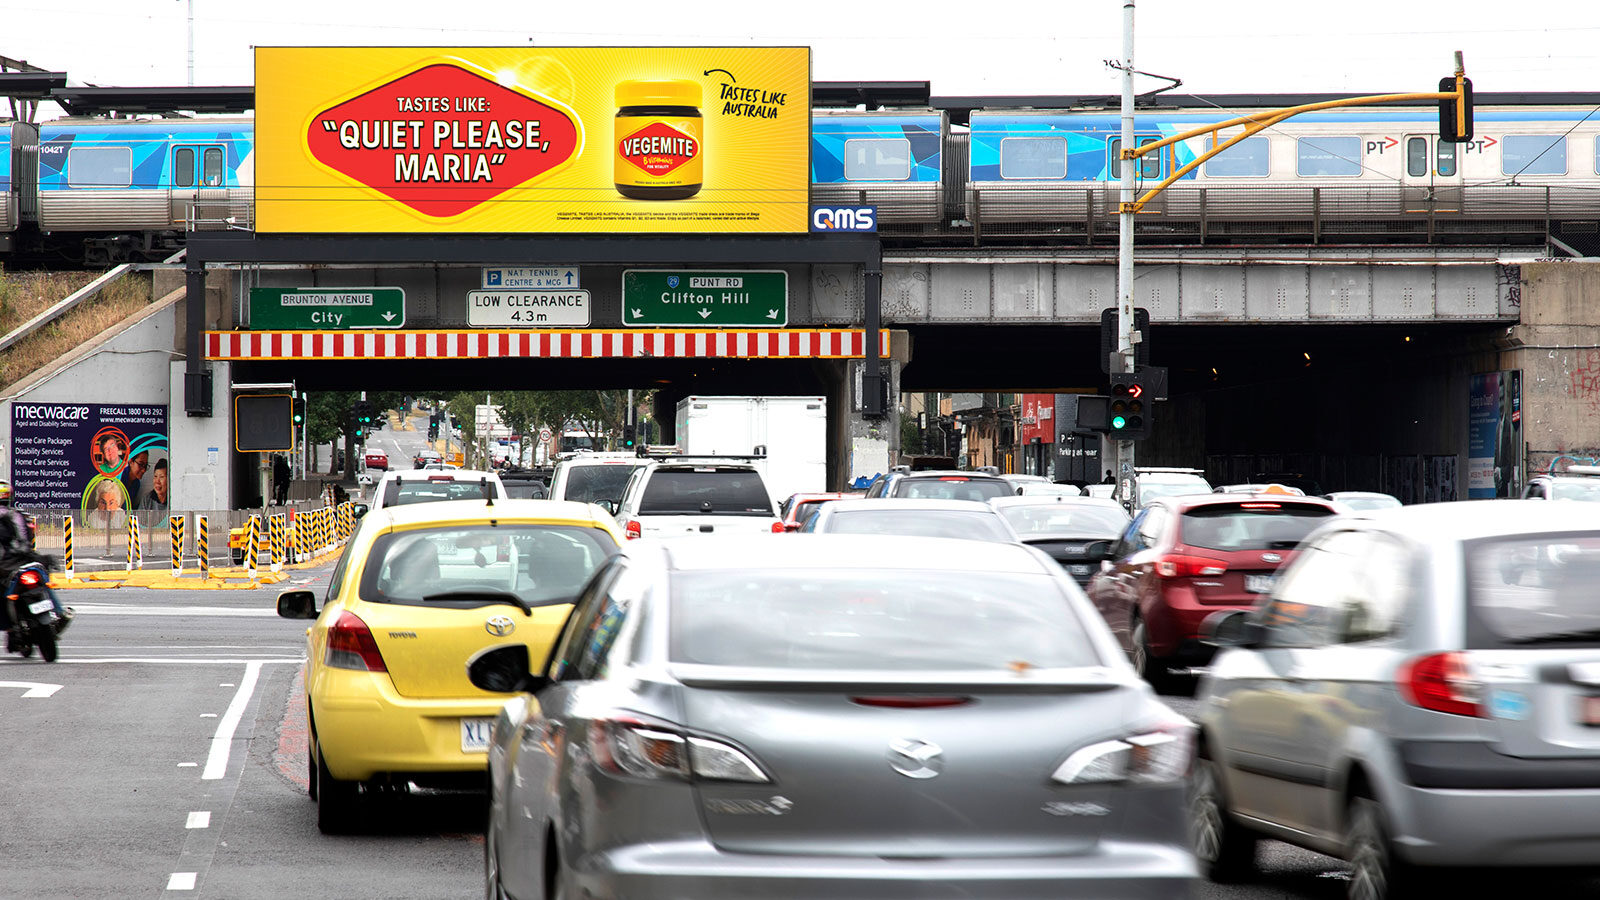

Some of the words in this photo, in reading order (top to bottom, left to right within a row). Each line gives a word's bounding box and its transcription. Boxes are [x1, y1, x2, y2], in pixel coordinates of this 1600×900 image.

[720, 83, 760, 106] TASTES
[761, 89, 787, 106] LIKE
[396, 97, 450, 112] TASTES
[455, 97, 491, 112] LIKE:
[722, 101, 778, 119] AUSTRALIA
[322, 120, 425, 149] "QUIET
[433, 120, 551, 152] PLEASE,
[623, 136, 693, 157] VEGEMITE
[394, 153, 507, 182] MARIA"
[529, 269, 559, 277] TENNIS
[504, 279, 534, 287] CENTRE
[537, 279, 543, 287] &
[546, 279, 562, 287] MCG
[669, 278, 678, 286] 29
[693, 277, 722, 287] PUNT
[726, 277, 740, 287] RD
[282, 295, 327, 304] BRUNTON
[333, 295, 371, 304] AVENUE
[475, 295, 501, 307] LOW
[507, 295, 583, 307] CLEARANCE
[661, 292, 714, 304] Clifton
[721, 292, 750, 304] Hill
[311, 312, 343, 325] City
[15, 405, 90, 420] mecwacare
[100, 407, 127, 415] FREECALL
[152, 408, 163, 416] 292
[16, 420, 29, 428] Aged
[39, 420, 59, 428] Disability
[100, 417, 164, 425] www.mecwacare.org.au
[33, 436, 47, 444] Care
[47, 436, 73, 446] Packages
[15, 447, 40, 456] Disability
[41, 447, 64, 455] Services
[47, 458, 70, 466] Services
[40, 469, 63, 478] Nursing
[15, 491, 39, 499] Housing
[14, 501, 47, 509] Community
